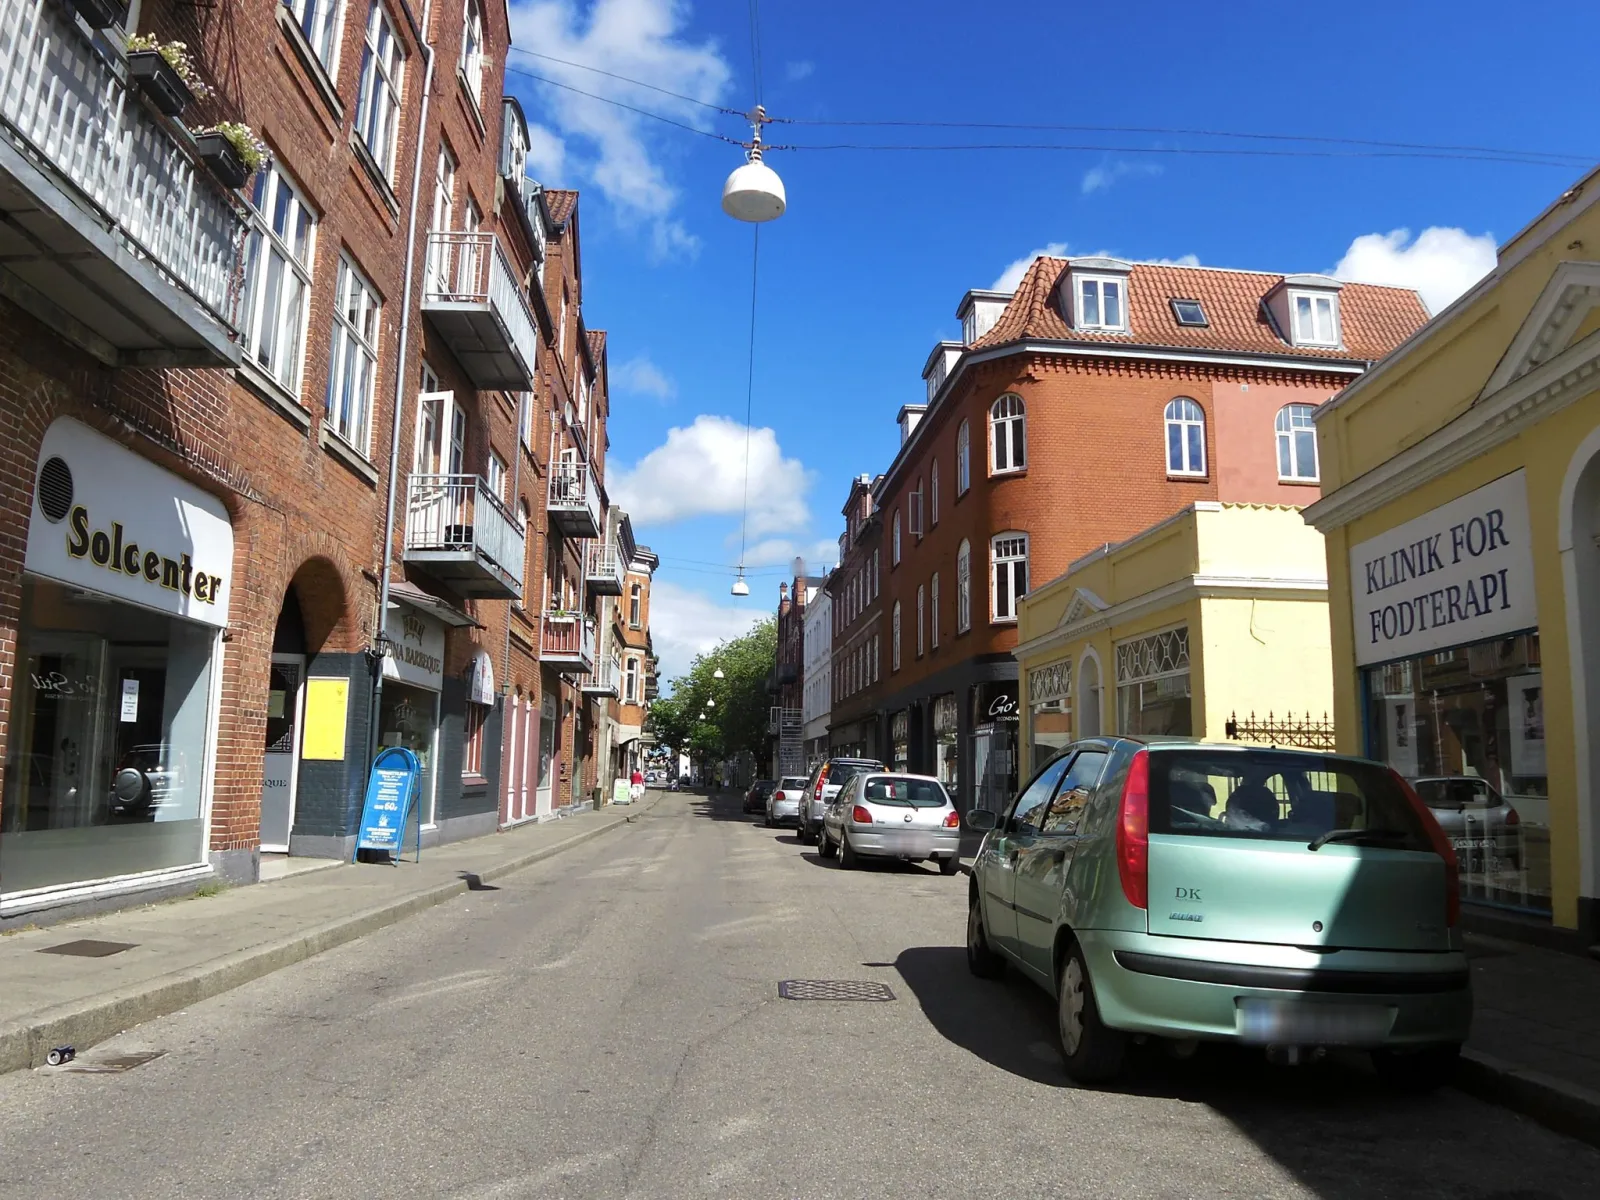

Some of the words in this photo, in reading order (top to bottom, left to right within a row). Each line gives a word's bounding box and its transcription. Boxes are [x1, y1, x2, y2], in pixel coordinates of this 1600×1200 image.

[66, 505, 222, 605] Solcenter
[1365, 532, 1446, 595] KLINIK
[1450, 508, 1510, 564] FOR
[1369, 568, 1512, 645] FODTERAPI
[405, 646, 441, 675] BARBEQUE
[1168, 911, 1204, 923] FIAT
[1175, 887, 1202, 900] DK
